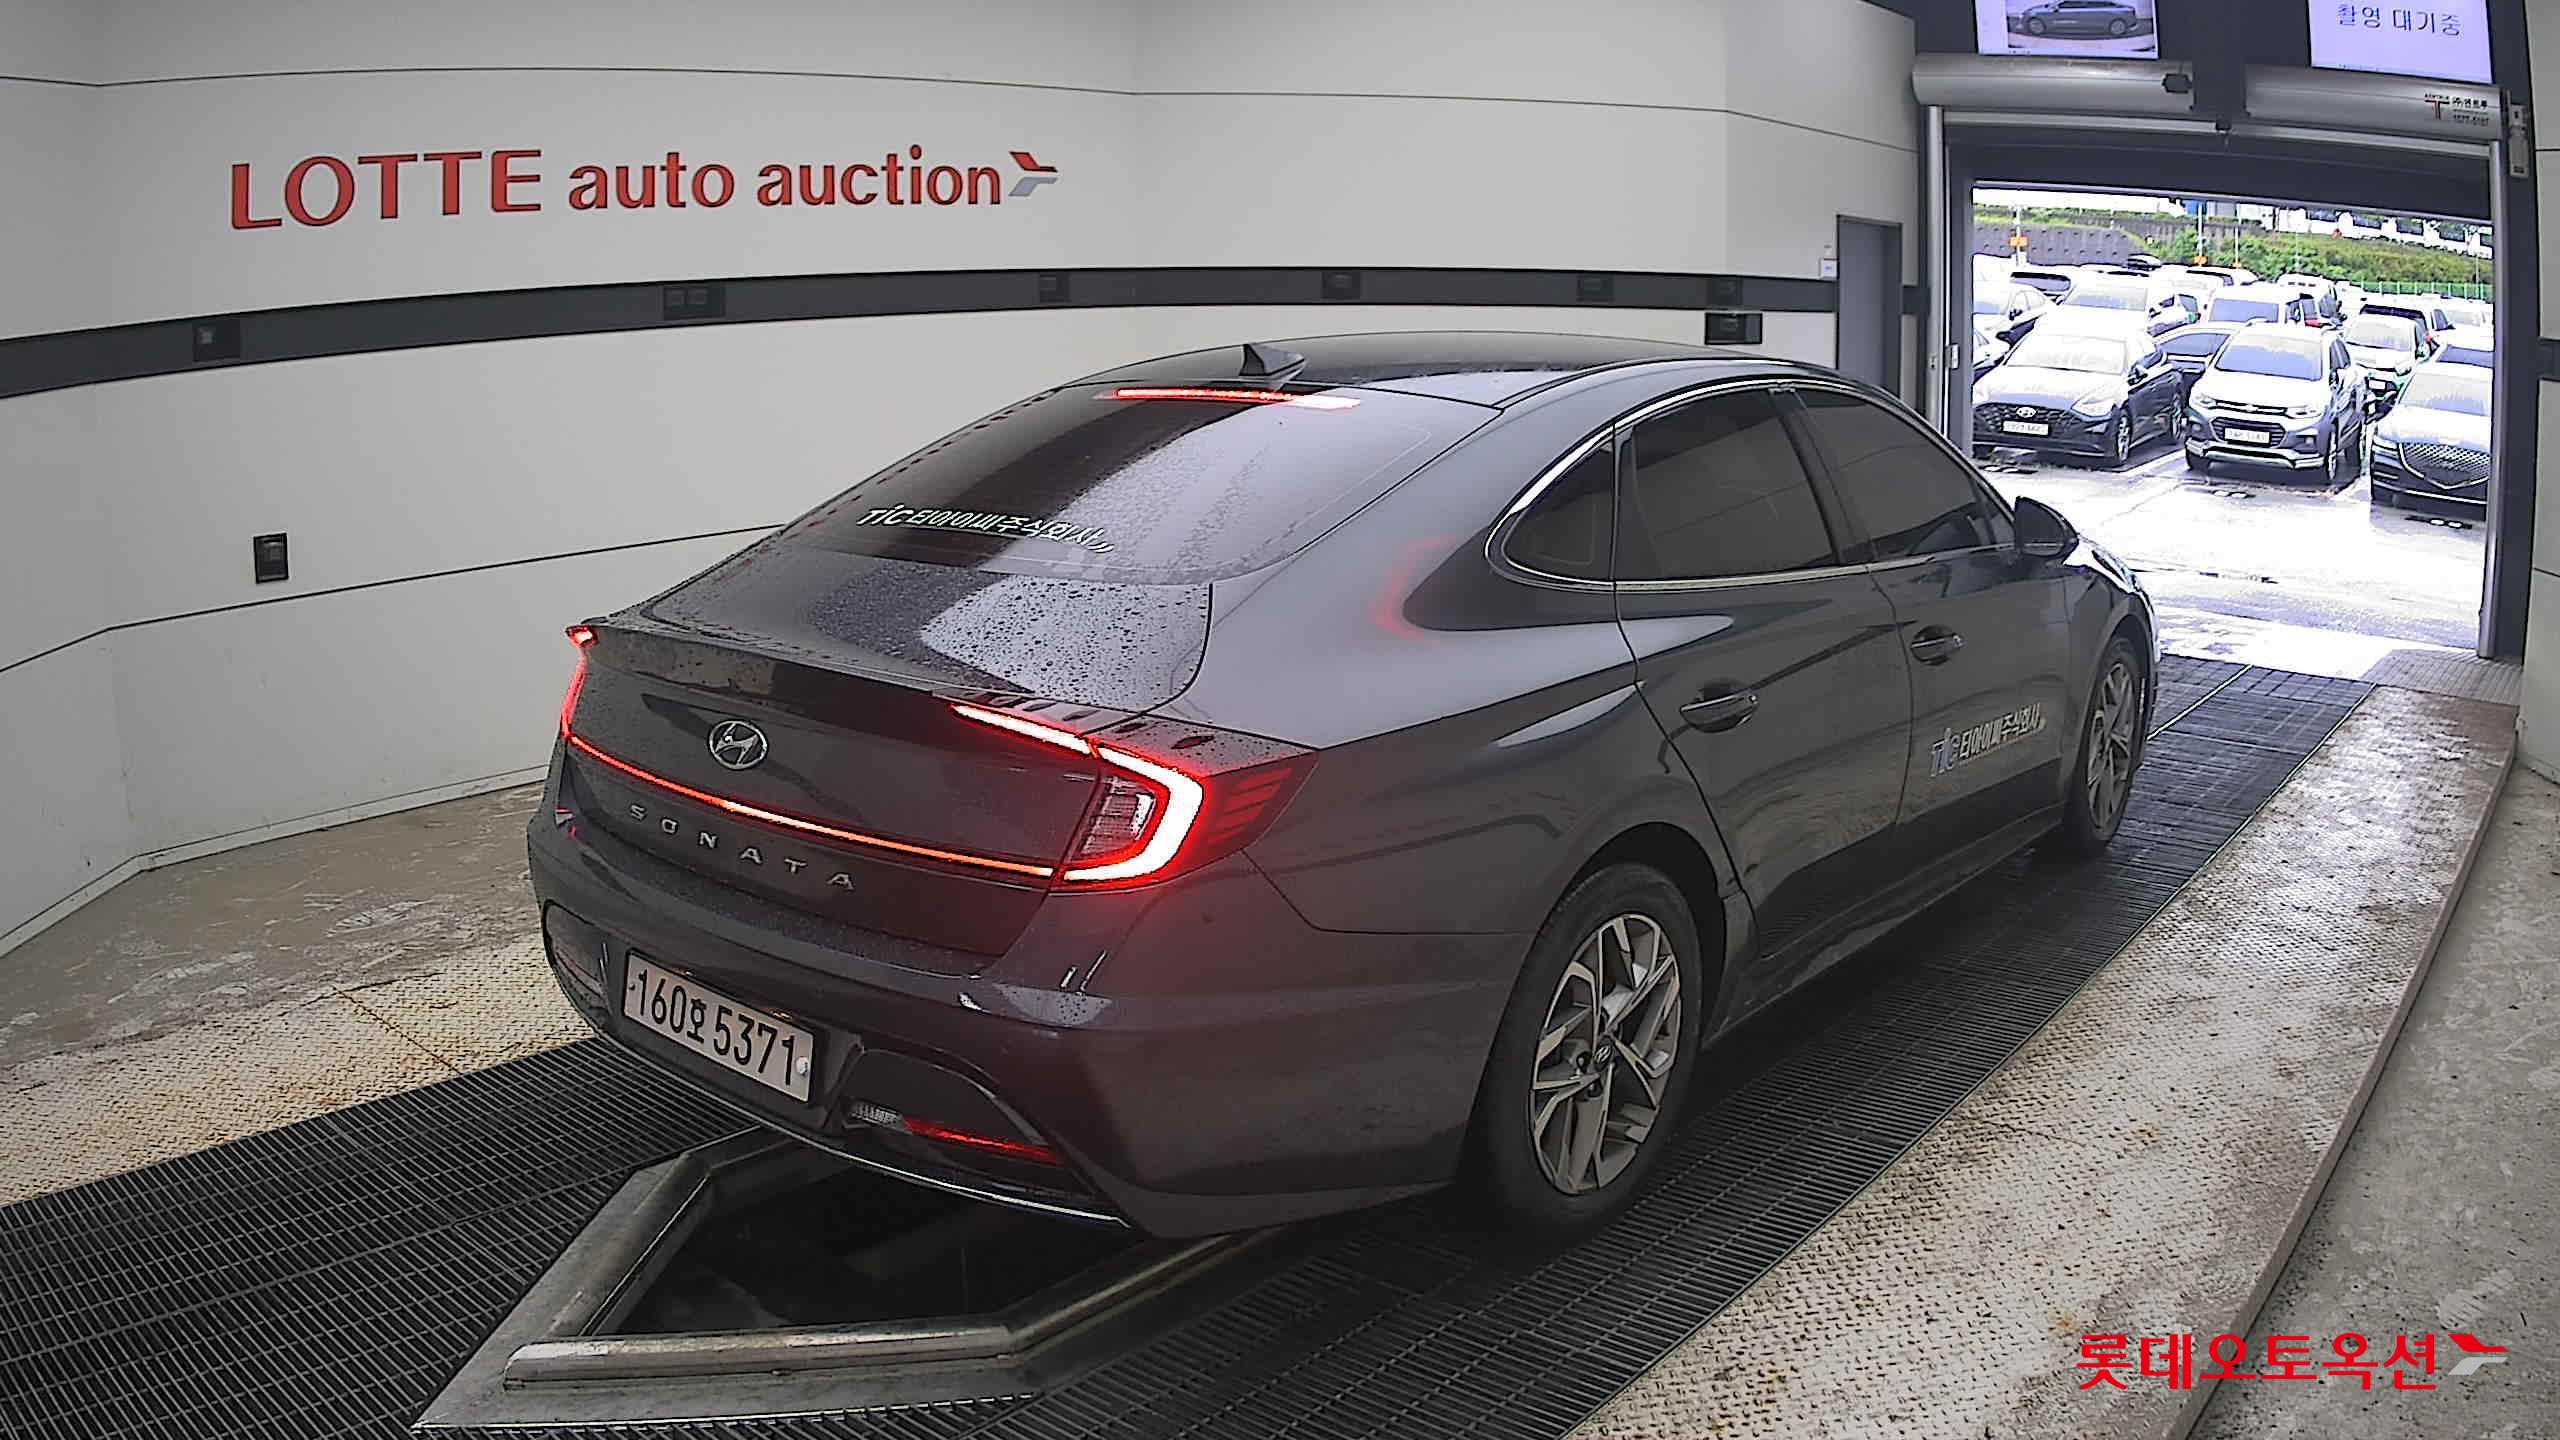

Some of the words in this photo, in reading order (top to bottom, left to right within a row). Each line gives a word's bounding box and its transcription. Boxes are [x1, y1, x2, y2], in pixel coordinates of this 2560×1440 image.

[2337, 3, 2381, 29] 촬영
[2392, 8, 2462, 37] 대기중
[231, 149, 543, 230] LOTTE
[568, 150, 735, 209] auto
[756, 144, 1002, 207] auction
[629, 803, 856, 891] SONATA
